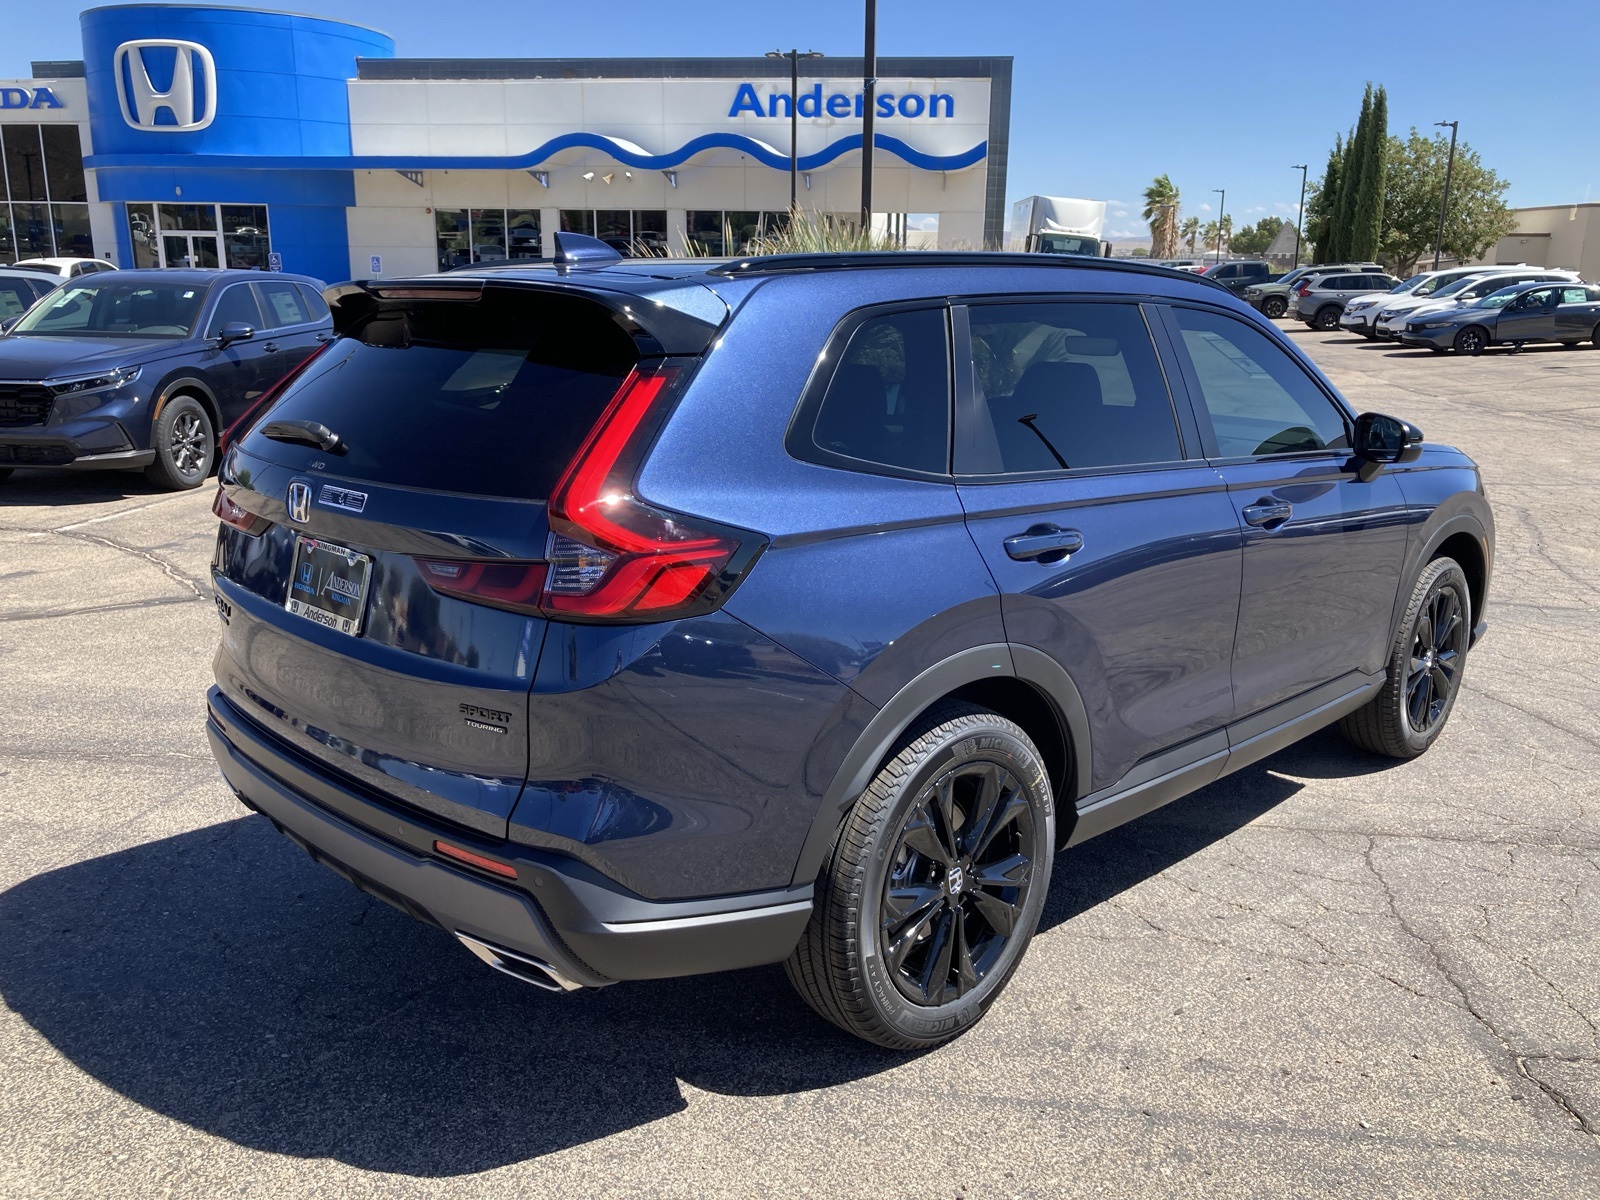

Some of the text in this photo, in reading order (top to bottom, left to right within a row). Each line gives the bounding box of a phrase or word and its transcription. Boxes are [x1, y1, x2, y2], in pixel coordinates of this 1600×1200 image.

[317, 541, 346, 555] KINGMAN
[320, 571, 361, 598] ANDERSON
[303, 606, 338, 628] Anderson
[459, 703, 513, 723] SPORT
[466, 720, 504, 734] TOURING
[980, 738, 1029, 766] MICHELIN
[873, 980, 896, 1015] PRIMACY
